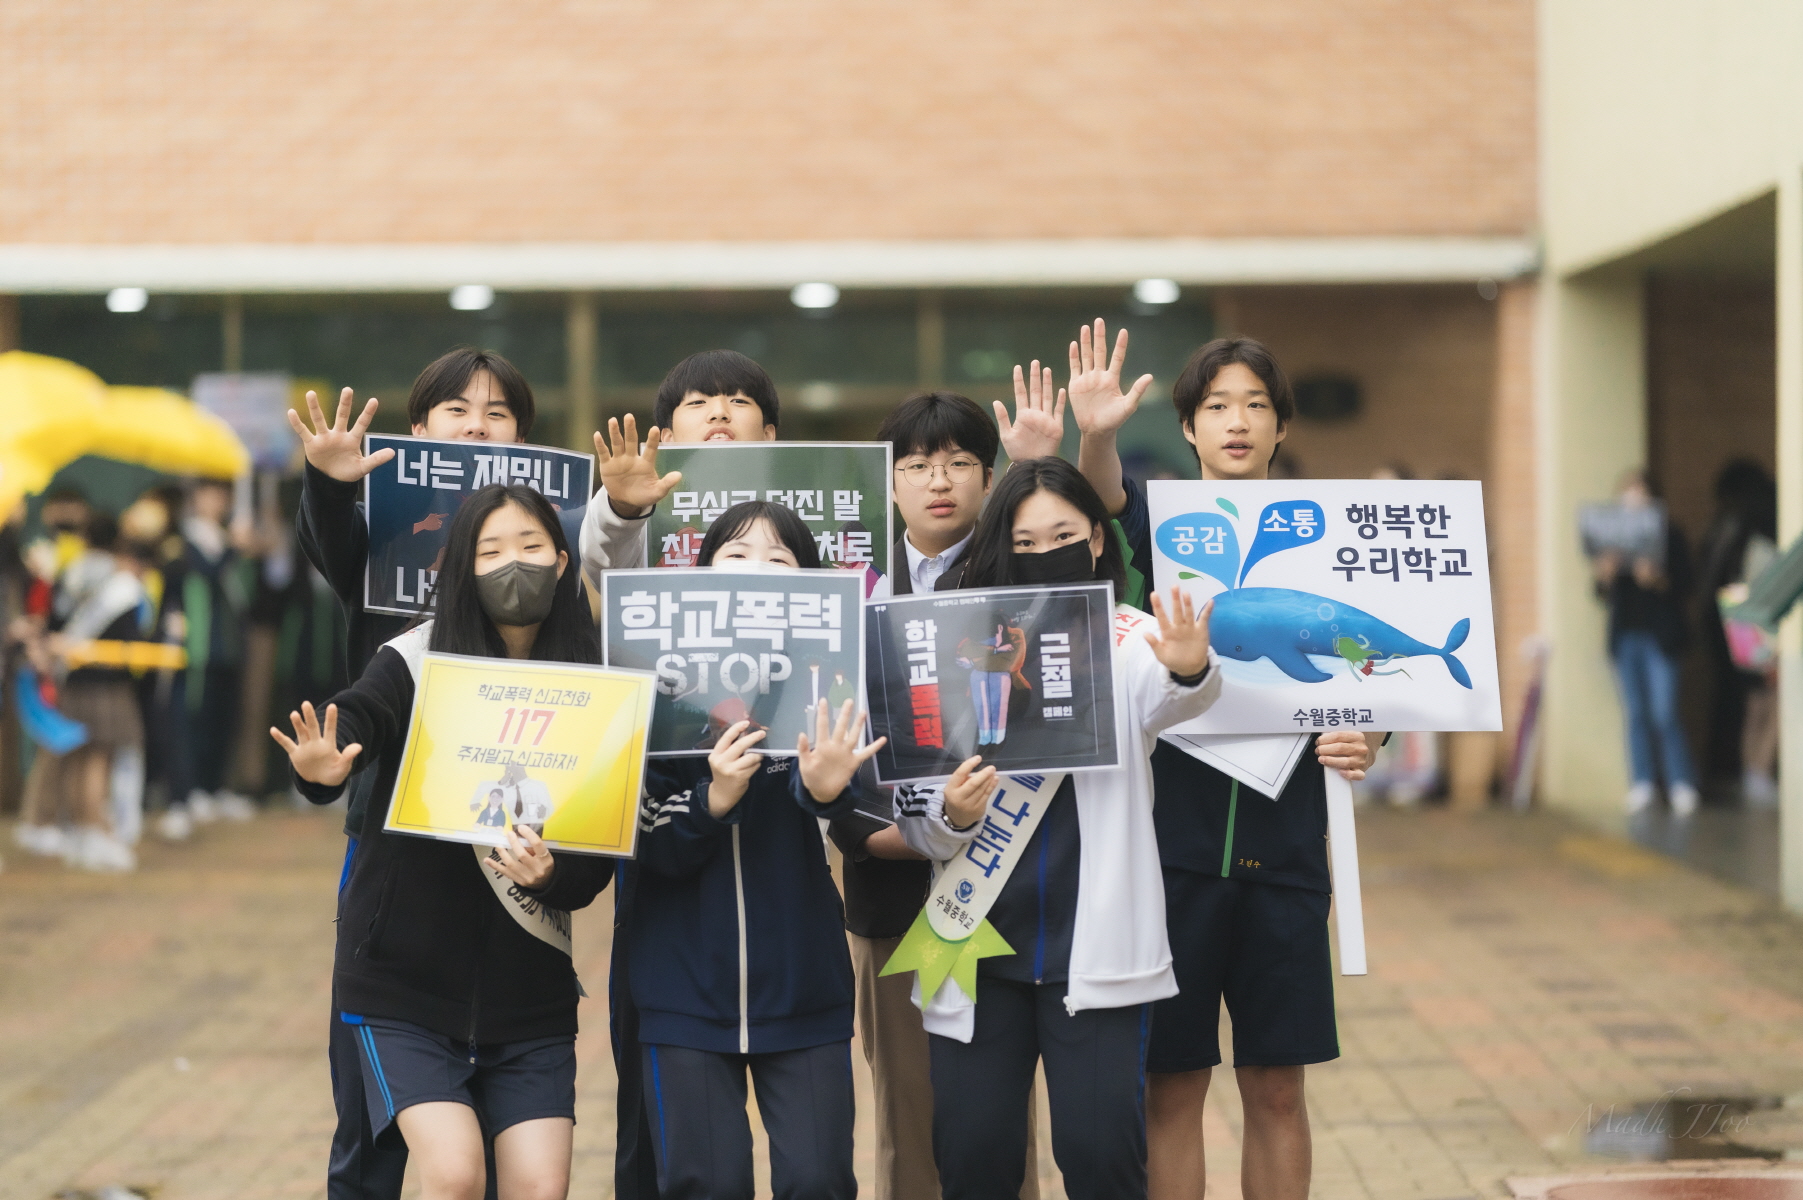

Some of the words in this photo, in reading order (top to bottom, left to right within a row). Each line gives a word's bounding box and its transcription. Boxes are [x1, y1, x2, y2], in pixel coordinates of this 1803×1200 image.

[397, 448, 464, 491] 너는
[472, 454, 570, 499] 재밌니
[834, 490, 863, 521] 말
[1346, 504, 1451, 540] 행복한
[1263, 509, 1318, 538] 소통
[811, 531, 874, 562] 처로
[1171, 526, 1227, 555] 공감
[1332, 547, 1472, 582] 우리학교
[620, 590, 842, 652] 학교폭력
[655, 652, 793, 696] STOP
[1040, 632, 1073, 699] 근절
[477, 684, 533, 703] 학교폭력
[534, 688, 592, 708] 신고전화
[1043, 705, 1073, 718] 캠페인
[497, 707, 556, 746] 117
[1293, 708, 1375, 727] 수월중학교
[457, 745, 514, 766] 주저말고
[516, 749, 578, 771] 신고하자!
[936, 894, 975, 930] 수월중학교
